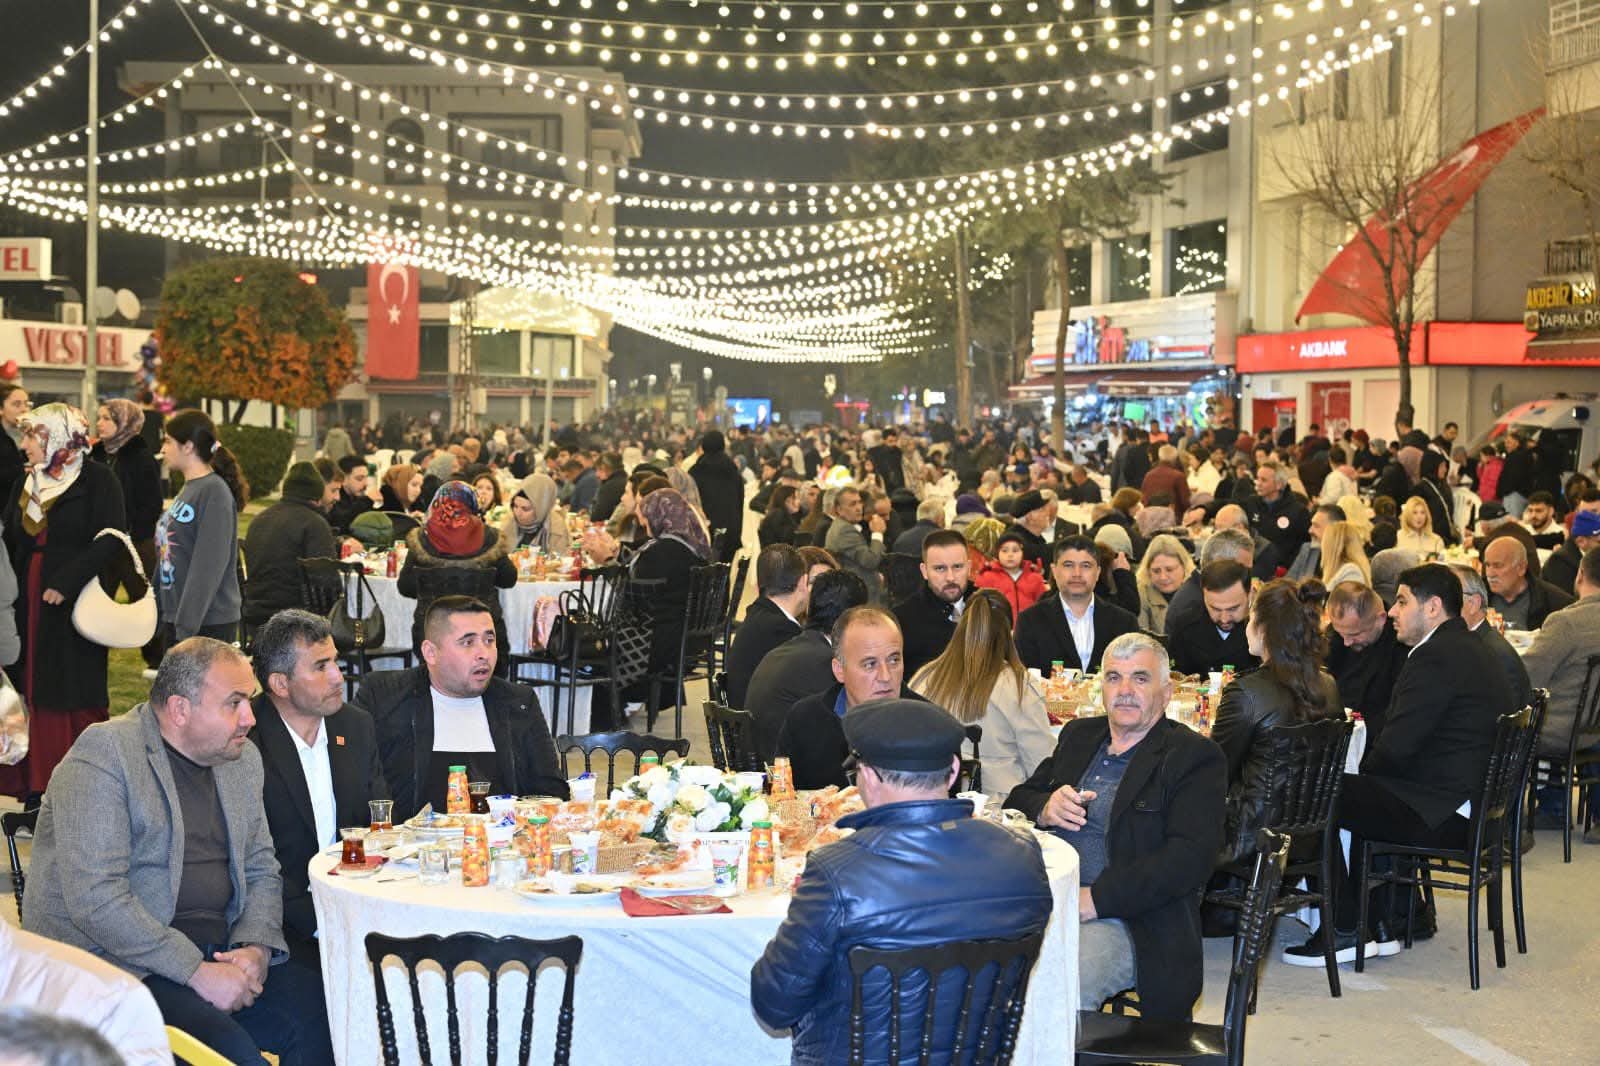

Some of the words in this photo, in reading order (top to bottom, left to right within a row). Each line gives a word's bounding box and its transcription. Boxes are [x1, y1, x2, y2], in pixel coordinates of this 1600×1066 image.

[0, 247, 37, 271] EL
[22, 327, 129, 367] VESTEL
[1300, 340, 1347, 357] AKBANK
